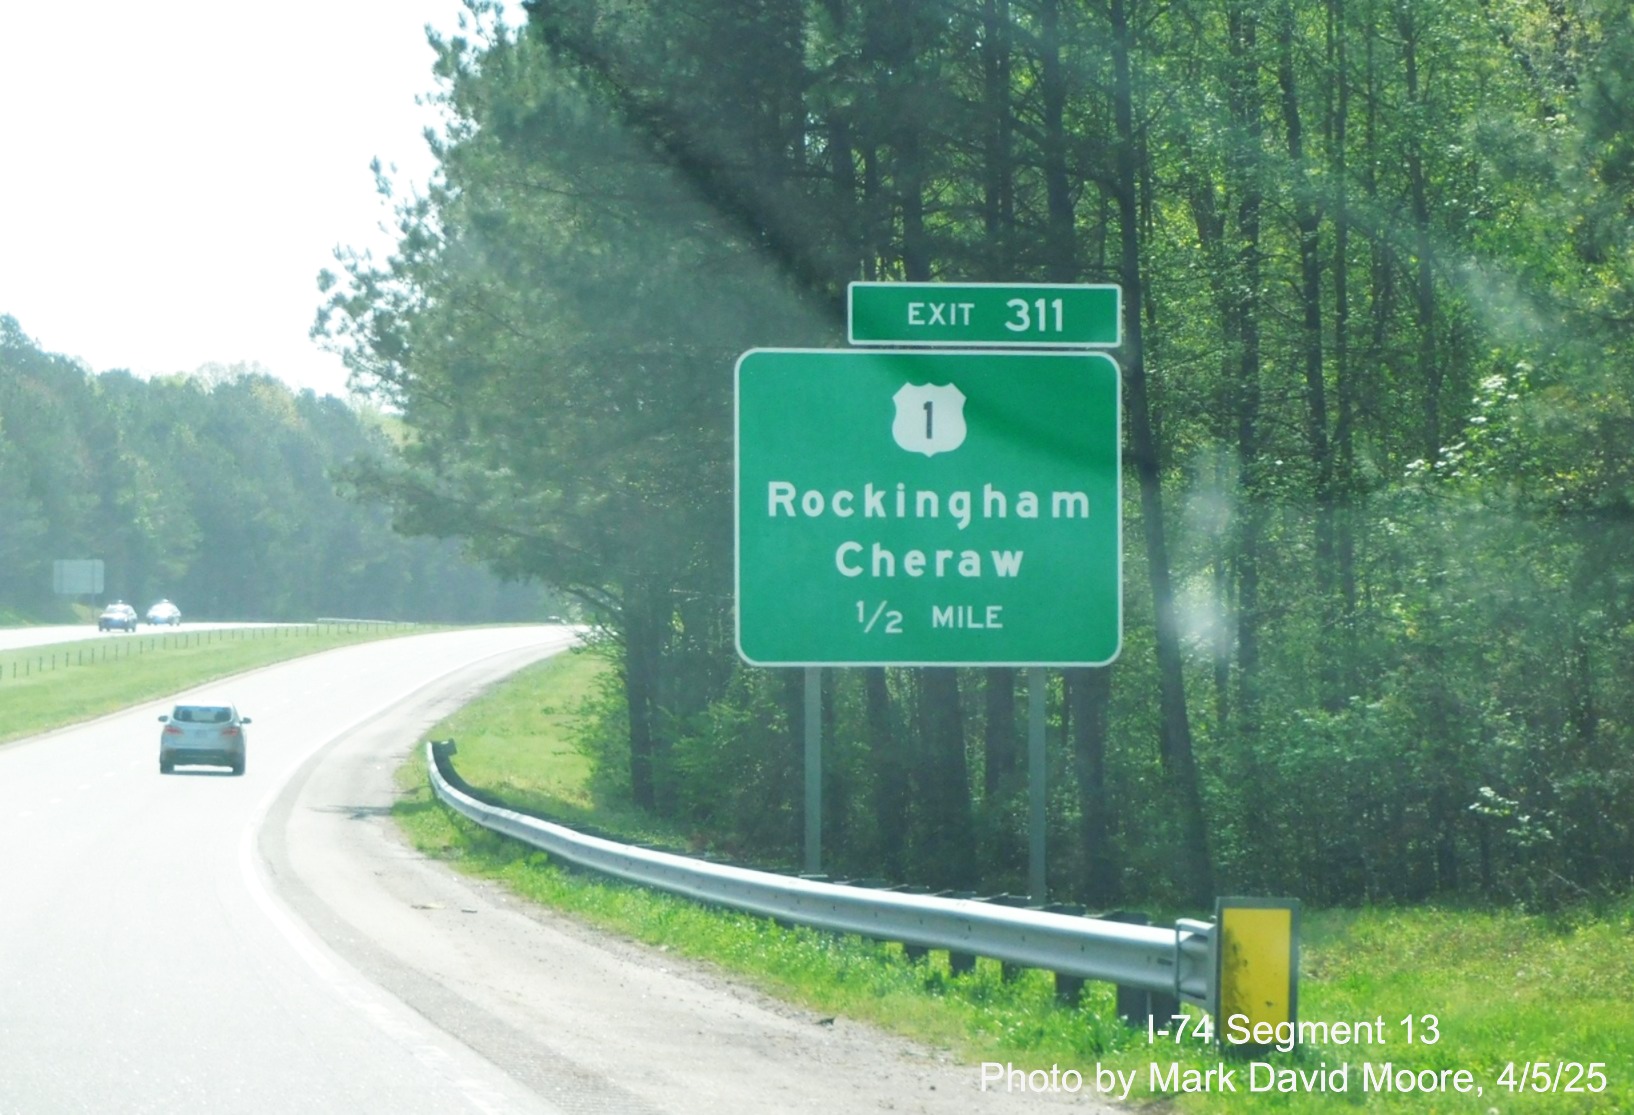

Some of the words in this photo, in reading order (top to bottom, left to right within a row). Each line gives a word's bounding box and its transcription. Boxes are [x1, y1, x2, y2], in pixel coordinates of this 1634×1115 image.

[908, 302, 975, 326] EXIT
[1004, 298, 1063, 332] 311
[922, 401, 934, 440] 1
[767, 481, 1090, 531] Rockingham
[835, 541, 1024, 578] Cheraw
[856, 600, 903, 634] 1/2
[932, 605, 1003, 629] MILE
